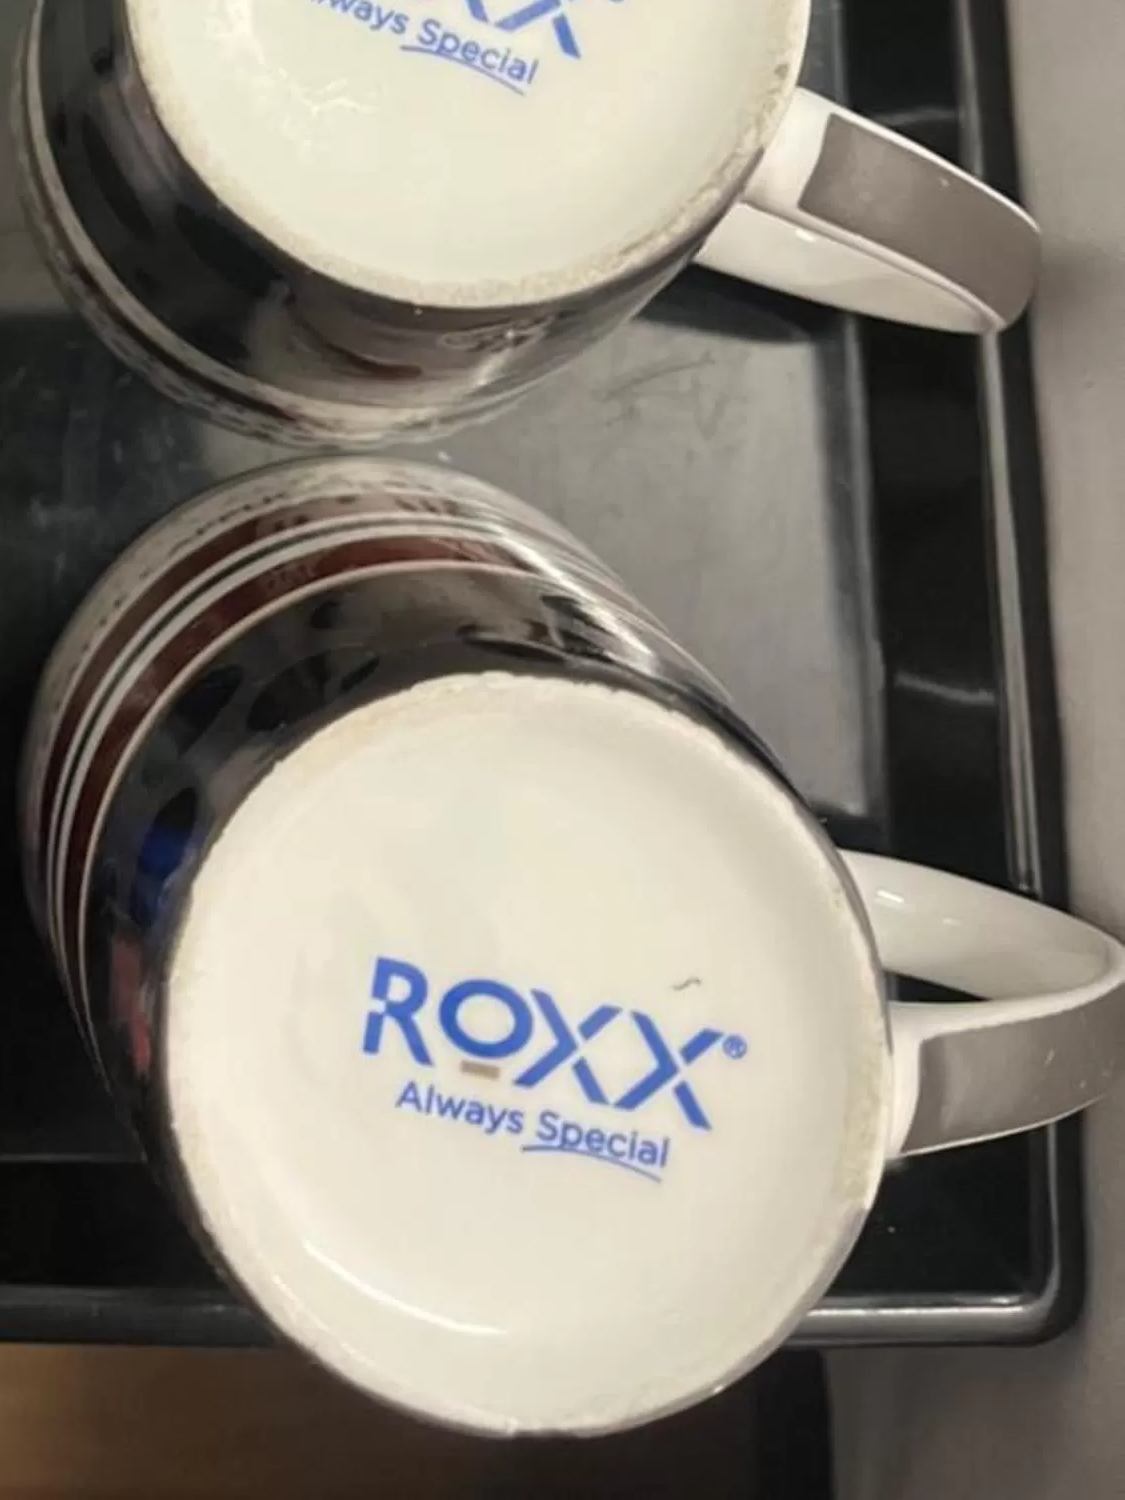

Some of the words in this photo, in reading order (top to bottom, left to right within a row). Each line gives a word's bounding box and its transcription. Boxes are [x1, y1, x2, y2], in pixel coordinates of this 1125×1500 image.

[416, 17, 540, 85] Special
[363, 957, 725, 1131] ROXX
[396, 1081, 524, 1136] Always
[535, 1110, 671, 1168] Special
